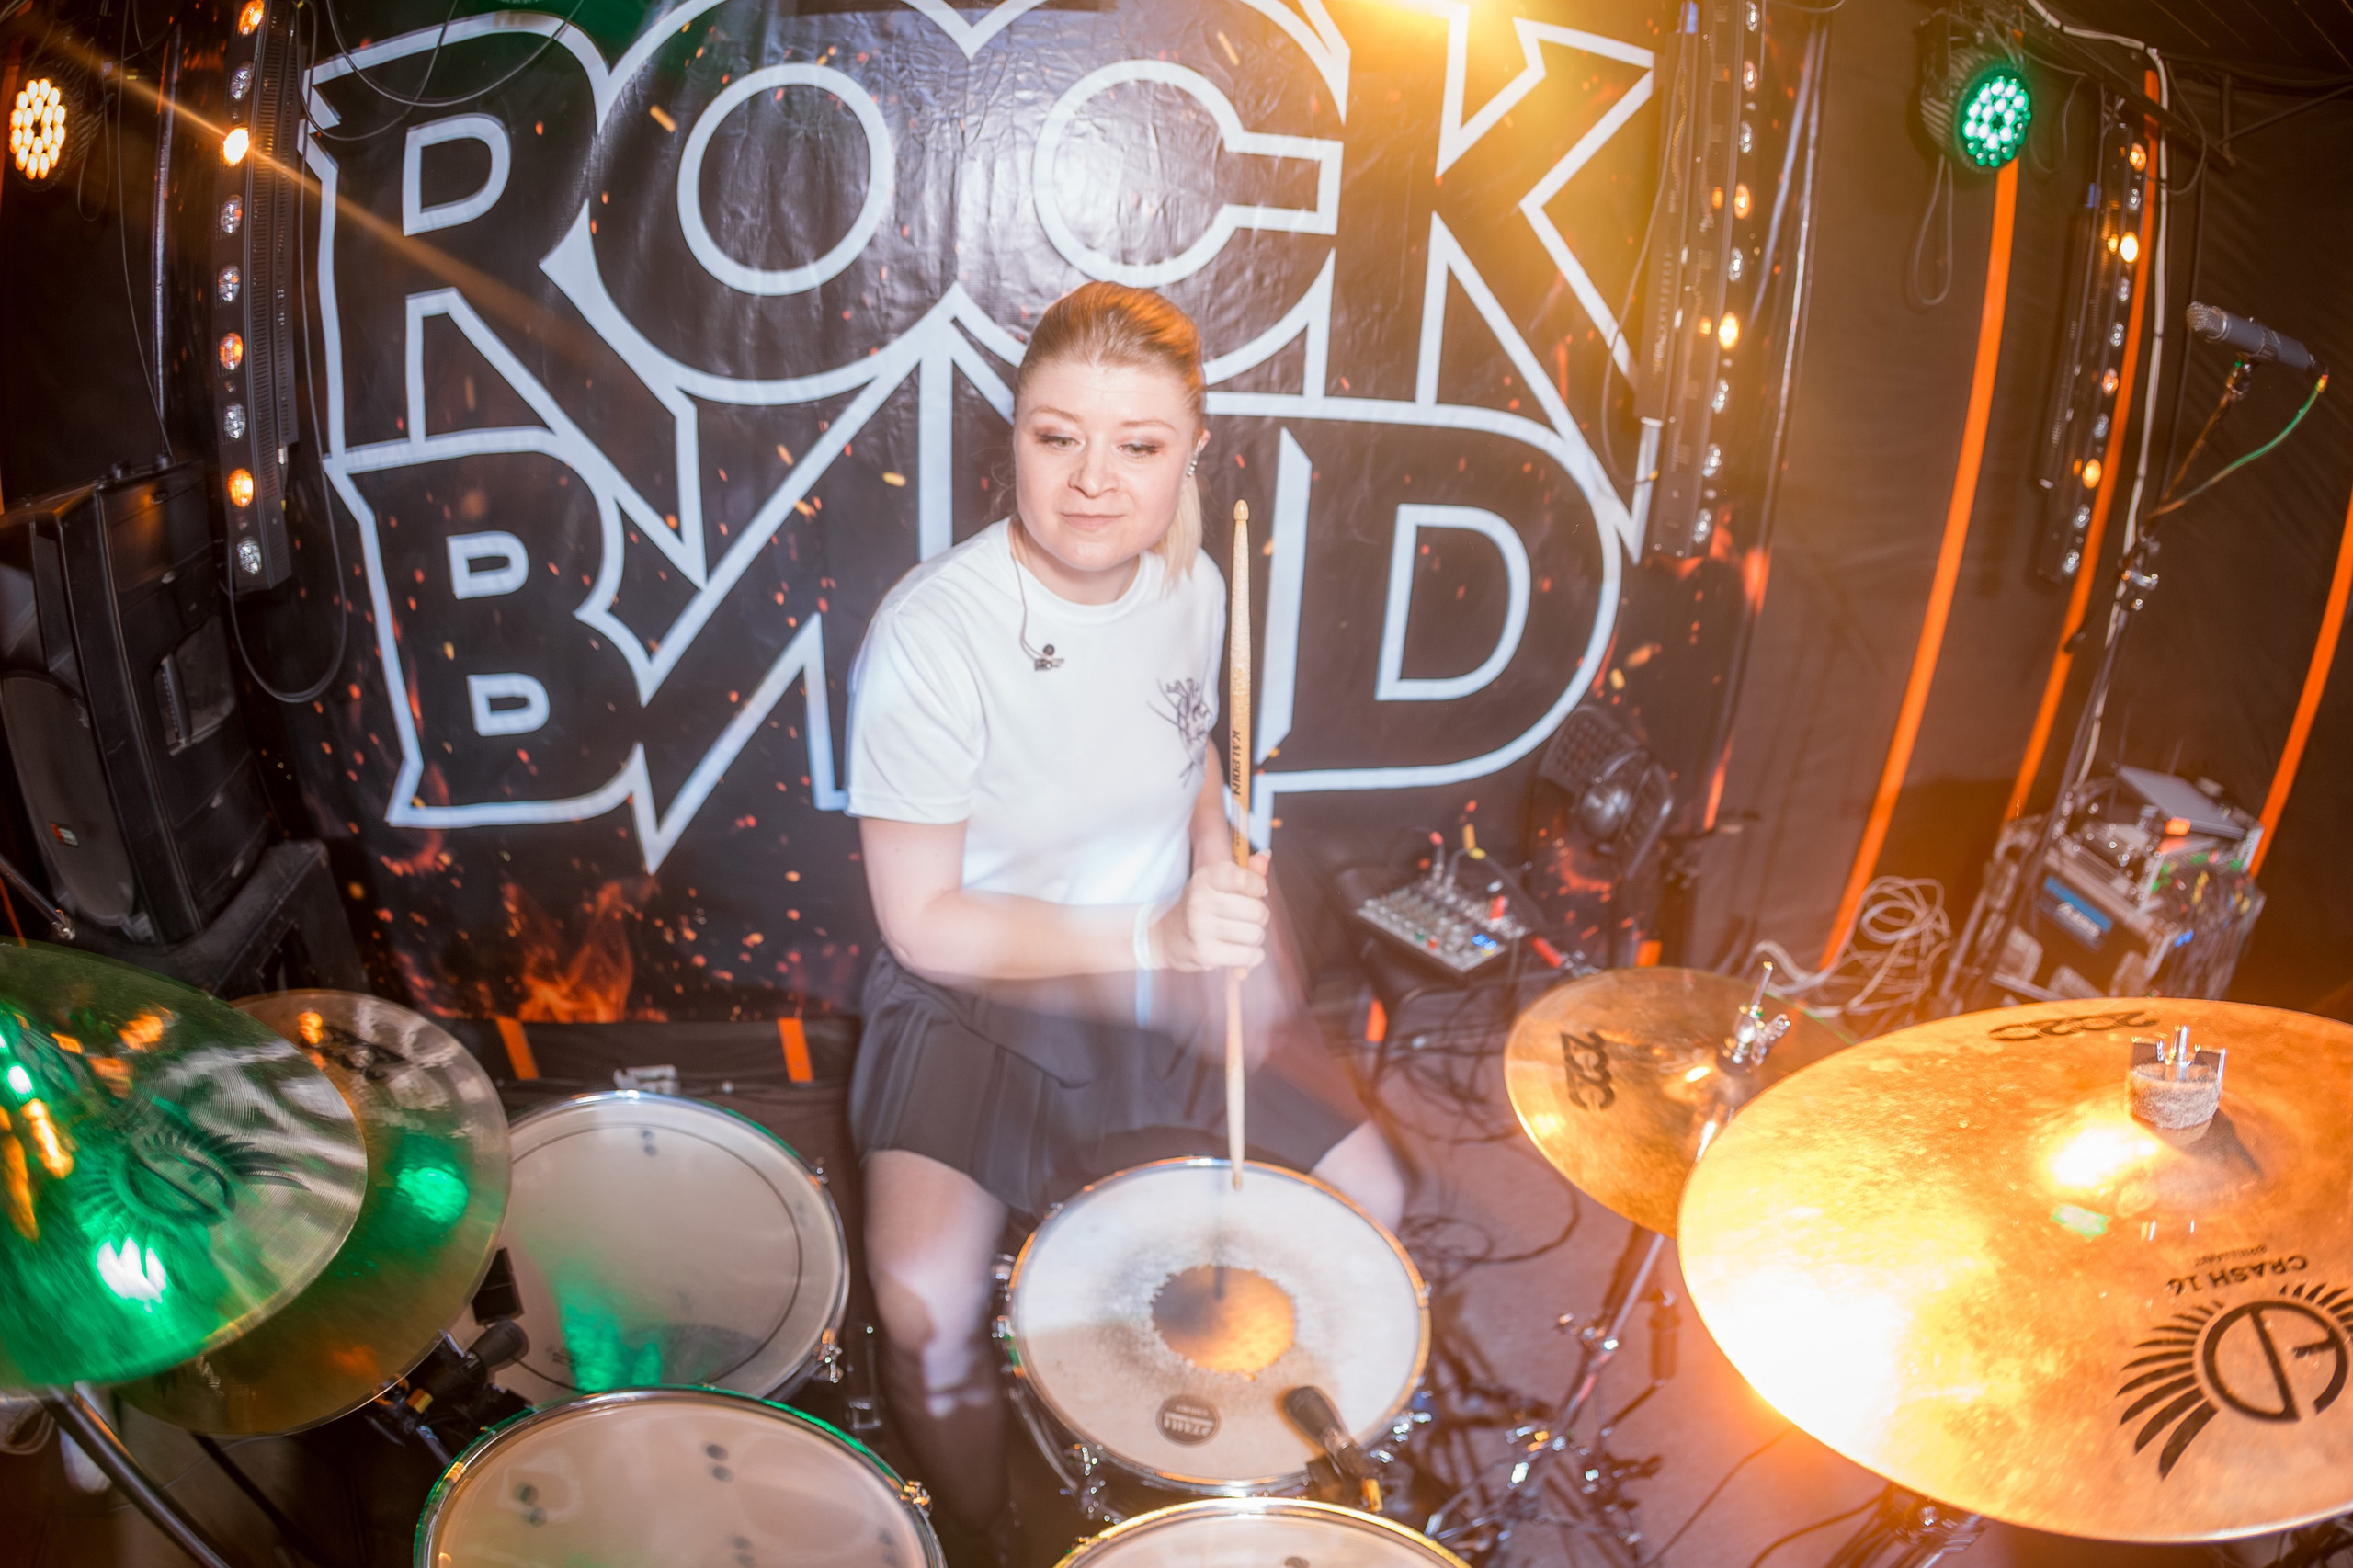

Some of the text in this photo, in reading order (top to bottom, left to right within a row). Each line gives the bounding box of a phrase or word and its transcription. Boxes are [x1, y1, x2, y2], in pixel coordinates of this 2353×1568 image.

[303, 0, 1657, 579] ROCK
[2167, 1256, 2309, 1297] CRASH 16
